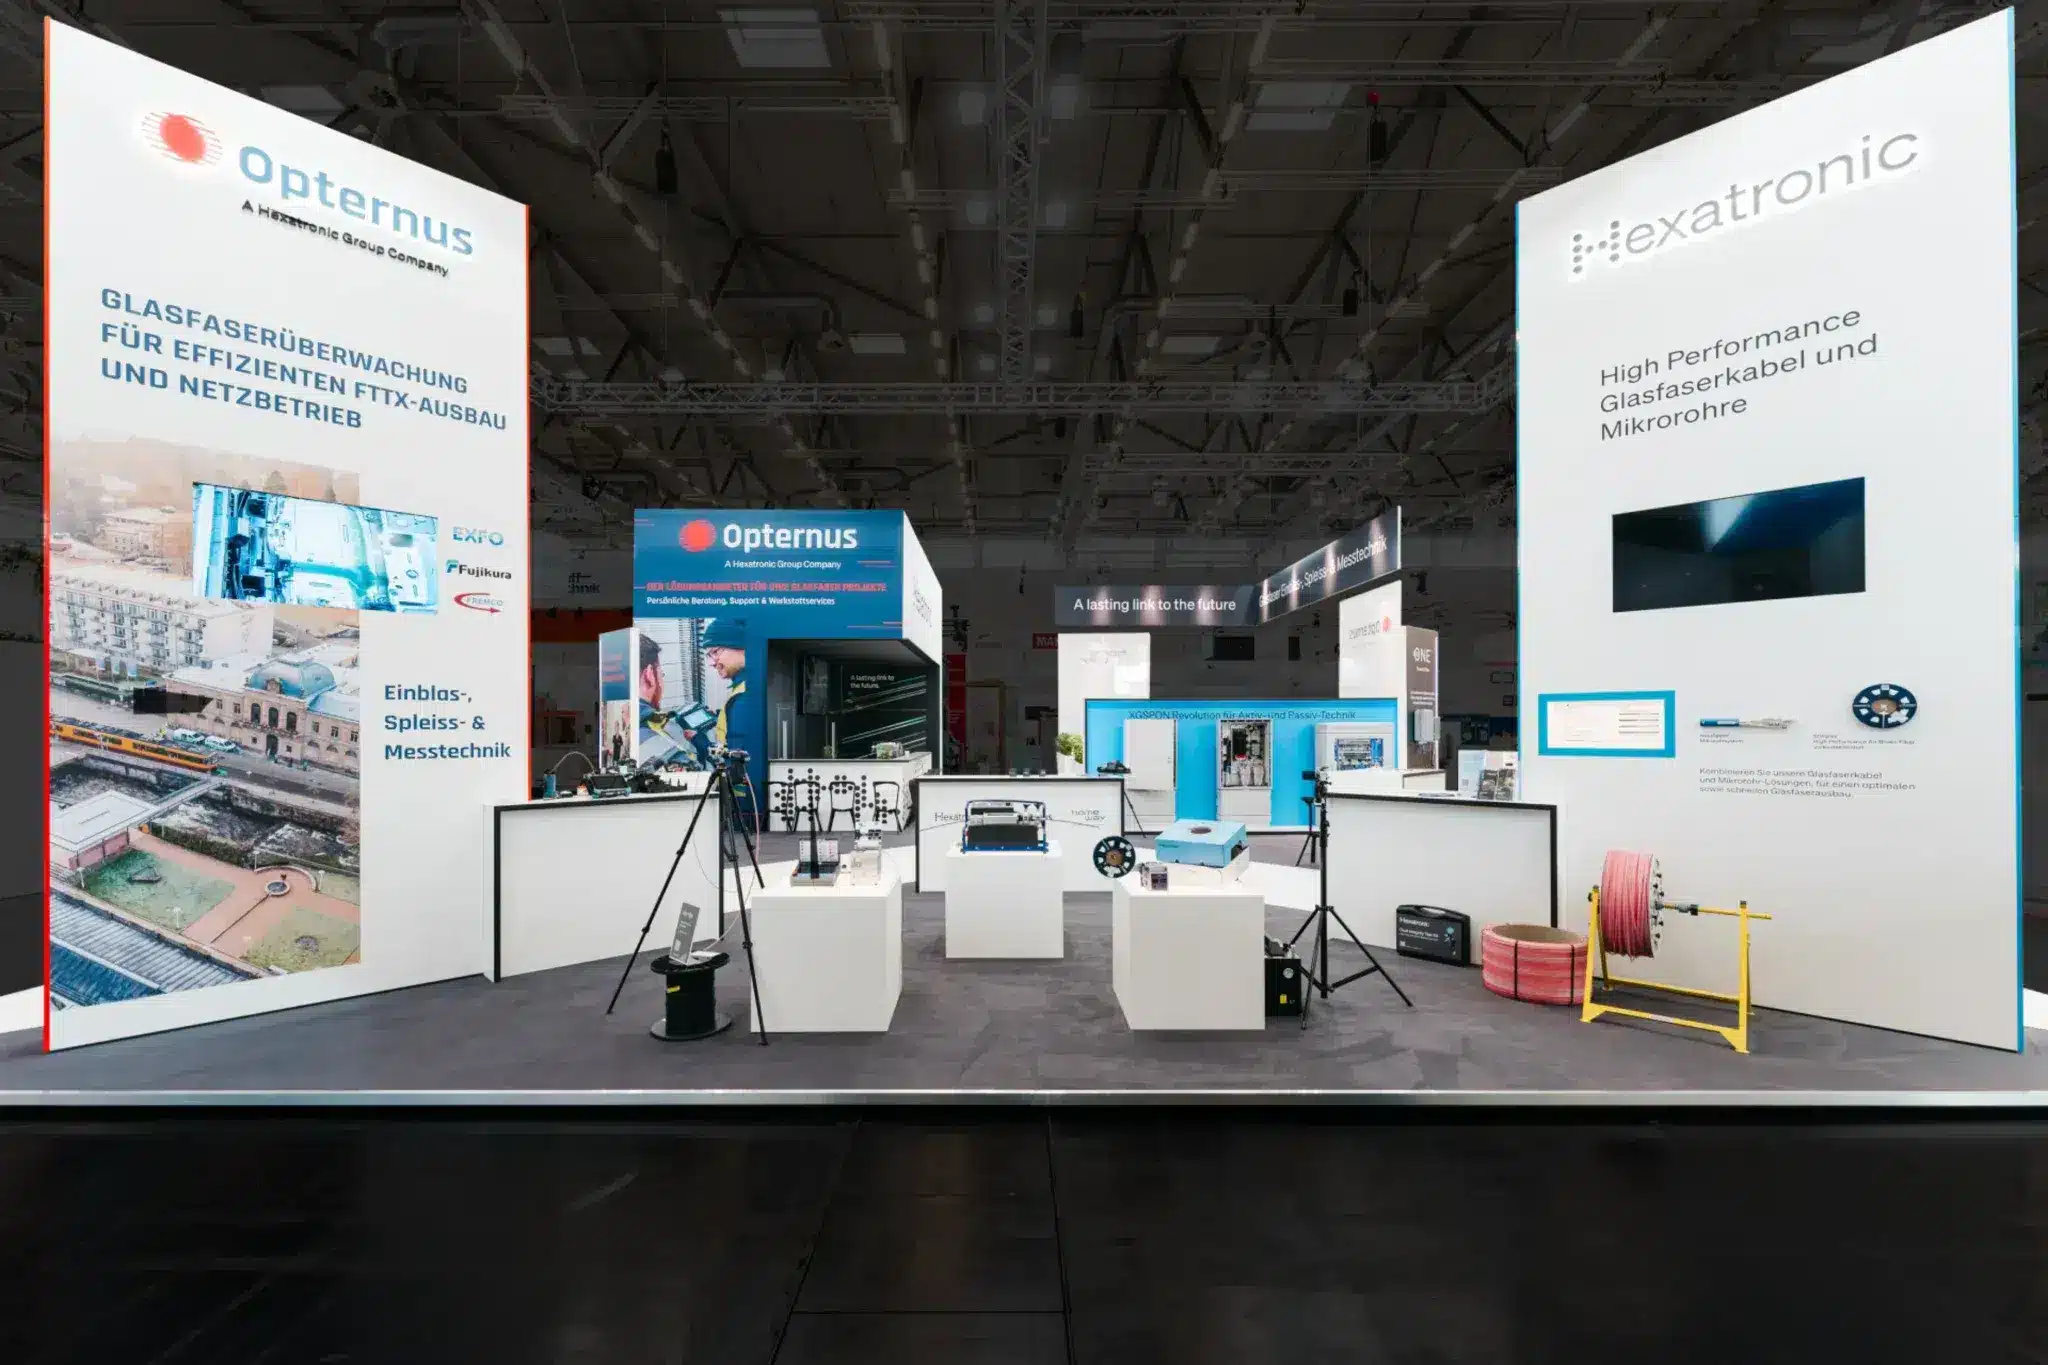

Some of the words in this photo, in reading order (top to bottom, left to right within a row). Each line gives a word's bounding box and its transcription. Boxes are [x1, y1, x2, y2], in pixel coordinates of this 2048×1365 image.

[238, 145, 474, 257] Opternus
[1571, 132, 1919, 275] Hexatronic
[241, 200, 255, 212] A
[257, 205, 339, 241] Hexatronic
[342, 232, 386, 256] Group
[388, 247, 450, 278] Company
[101, 287, 468, 395] GLASFASERÜBERWACHUNG
[1601, 357, 1659, 387] High
[1667, 309, 1861, 371] Performance
[101, 322, 163, 355] FÜR
[174, 339, 347, 396] EFFIZIENTEN
[354, 382, 508, 432] FTTX-AUSBAU
[1600, 349, 1805, 413] Glasfaserkabel
[1816, 333, 1878, 366] und
[101, 357, 169, 391] UND
[179, 374, 363, 430] NETZBETRIEB
[1601, 397, 1748, 441] Mikrorohre
[452, 526, 505, 546] EXFO
[723, 523, 858, 554] Opternus
[1336, 534, 1388, 571] Messtechnik
[458, 563, 512, 580] Fujikura
[724, 560, 731, 568] A
[732, 560, 776, 568] Hexatronic
[777, 560, 802, 570] Group
[803, 560, 841, 570] Company
[646, 596, 690, 605] Persönliche
[691, 596, 728, 606] Beratung,
[729, 596, 760, 606] Support
[761, 597, 767, 605] &
[768, 596, 836, 606] Werkstattservices
[1073, 598, 1084, 611] A
[1086, 598, 1129, 613] lasting
[1132, 598, 1156, 611] link
[1158, 600, 1172, 611] to
[1173, 598, 1195, 611] the
[1197, 598, 1237, 611] future
[384, 683, 472, 703] Einblas-,
[384, 714, 467, 734] Spleiss-
[472, 715, 486, 731] &
[1172, 710, 1221, 720] Revolution
[1223, 710, 1235, 720] für
[384, 742, 511, 761] Messtechnik
[1699, 768, 1755, 776] Kombinieren
[1757, 769, 1772, 777] Sie
[1807, 770, 1883, 780] Glasfaserkabel
[1726, 786, 1769, 795] schnellen
[1861, 782, 1917, 790] optimalen
